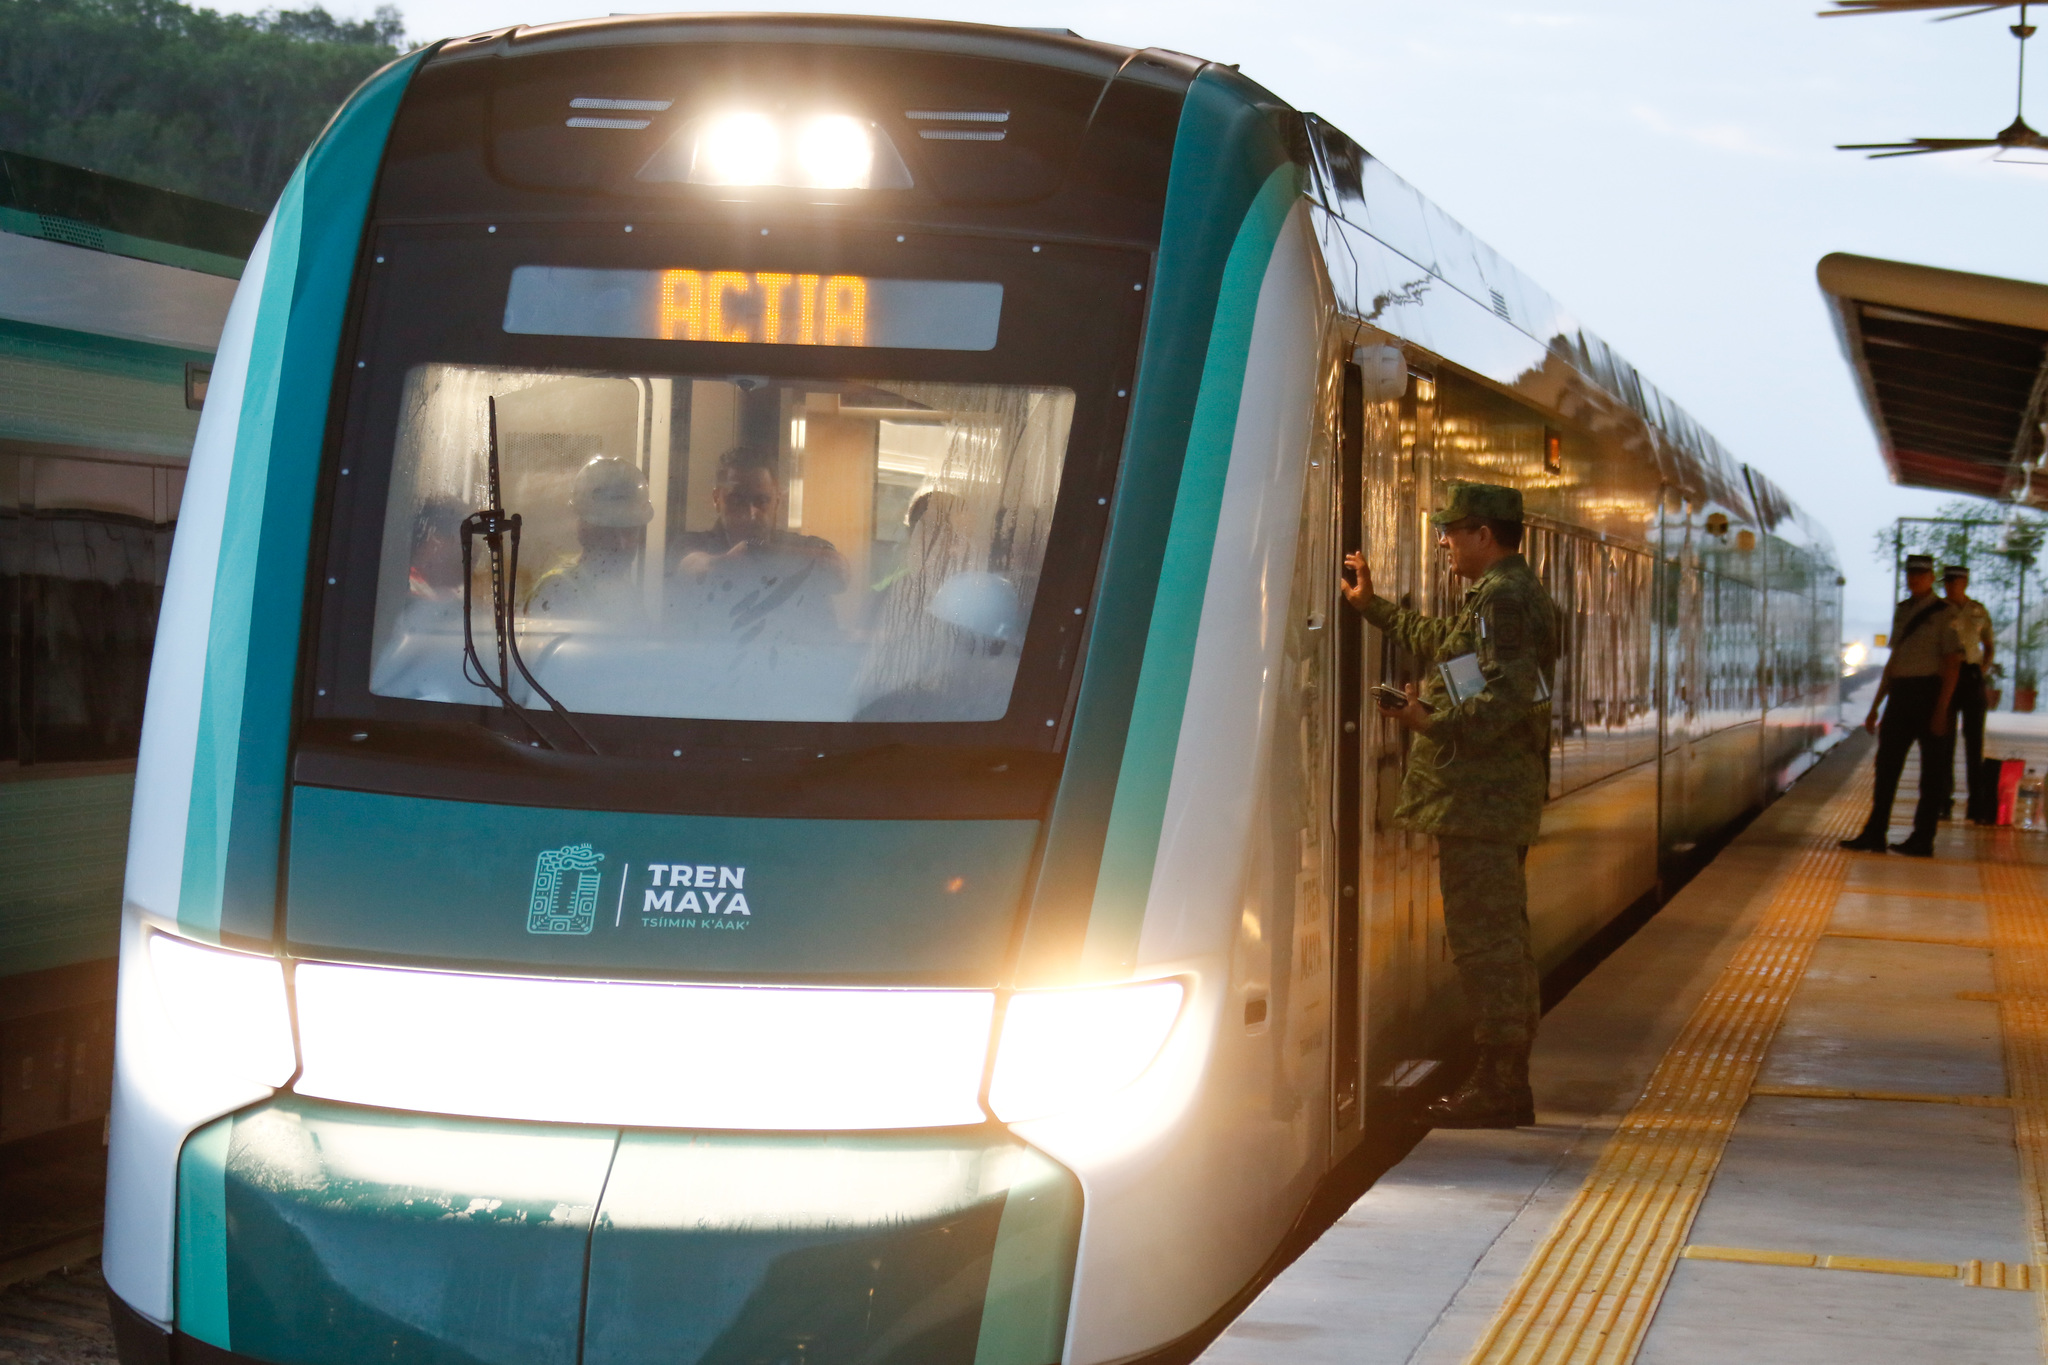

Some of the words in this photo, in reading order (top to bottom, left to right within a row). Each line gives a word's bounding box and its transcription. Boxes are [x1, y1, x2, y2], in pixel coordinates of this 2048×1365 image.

[661, 269, 866, 346] ACTIA
[648, 864, 746, 889] TREN
[642, 889, 752, 916] MAYA
[641, 916, 697, 929] TSÍIMIN
